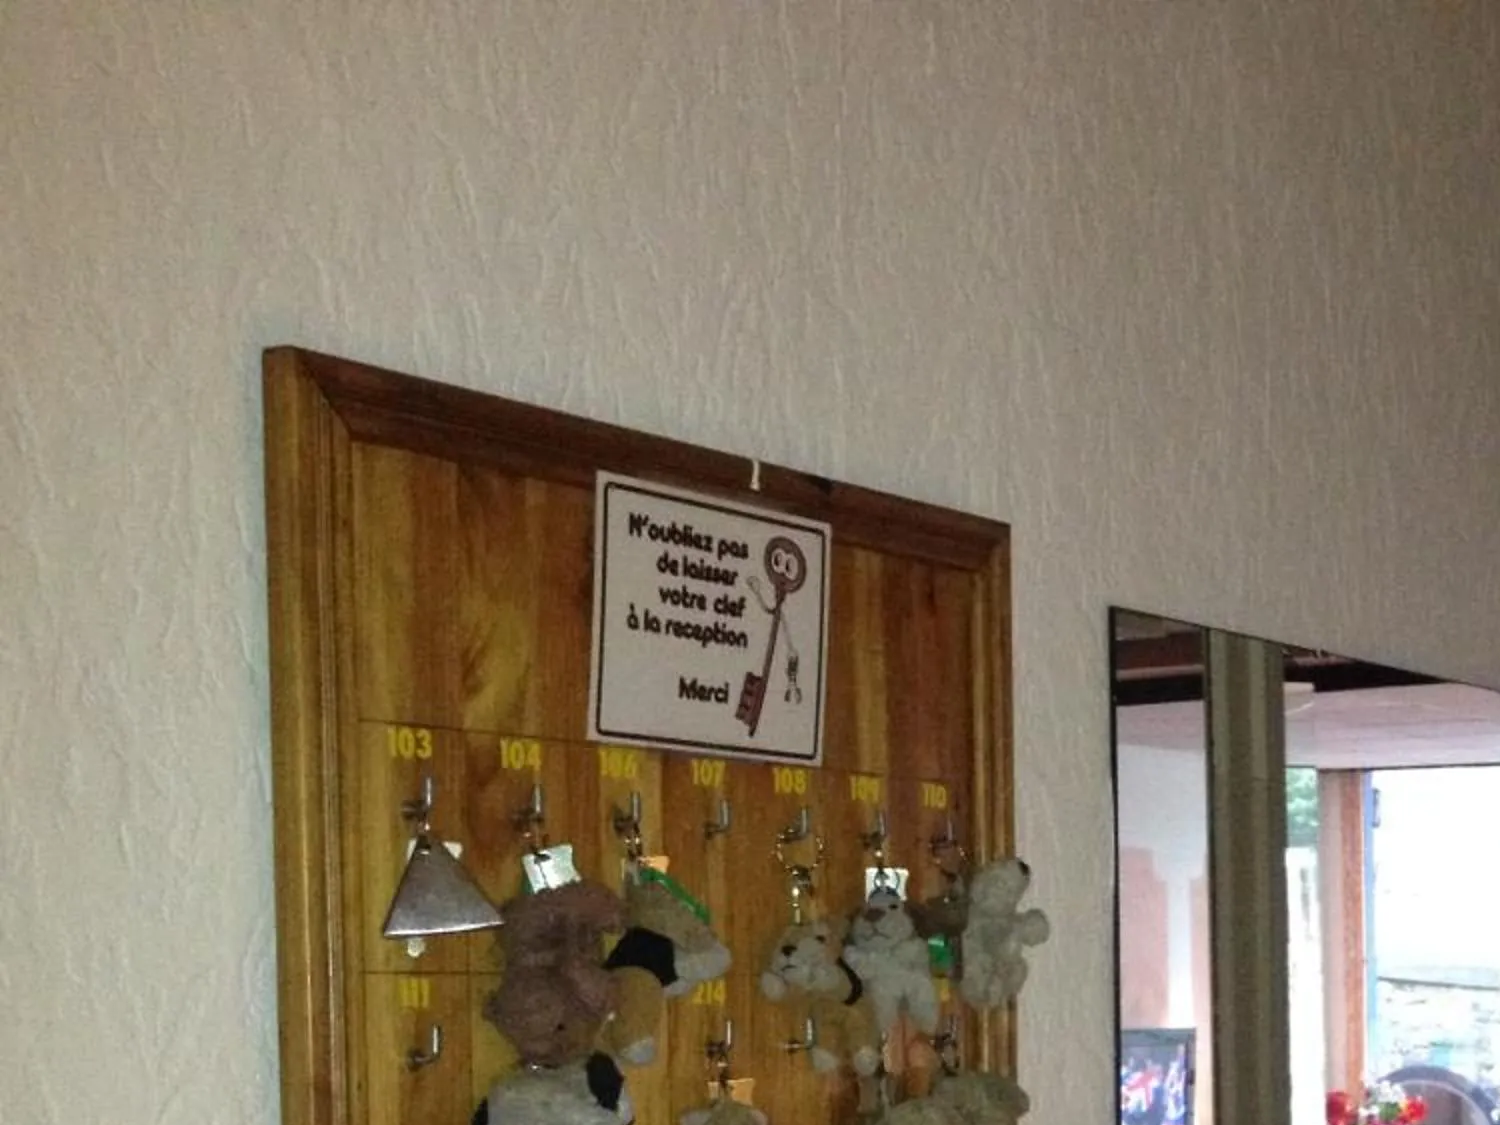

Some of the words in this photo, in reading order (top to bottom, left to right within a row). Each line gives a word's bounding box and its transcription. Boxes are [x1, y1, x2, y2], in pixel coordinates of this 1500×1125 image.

[717, 538, 748, 562] pas
[656, 551, 679, 573] de
[683, 556, 738, 586] laisser
[658, 585, 706, 611] votre
[713, 597, 746, 618] clef
[626, 603, 638, 631] à
[644, 608, 661, 634] la
[665, 619, 748, 649] reception
[678, 677, 729, 704] Merci
[387, 728, 432, 758] 103
[501, 740, 541, 771] 104
[692, 759, 725, 787] 107
